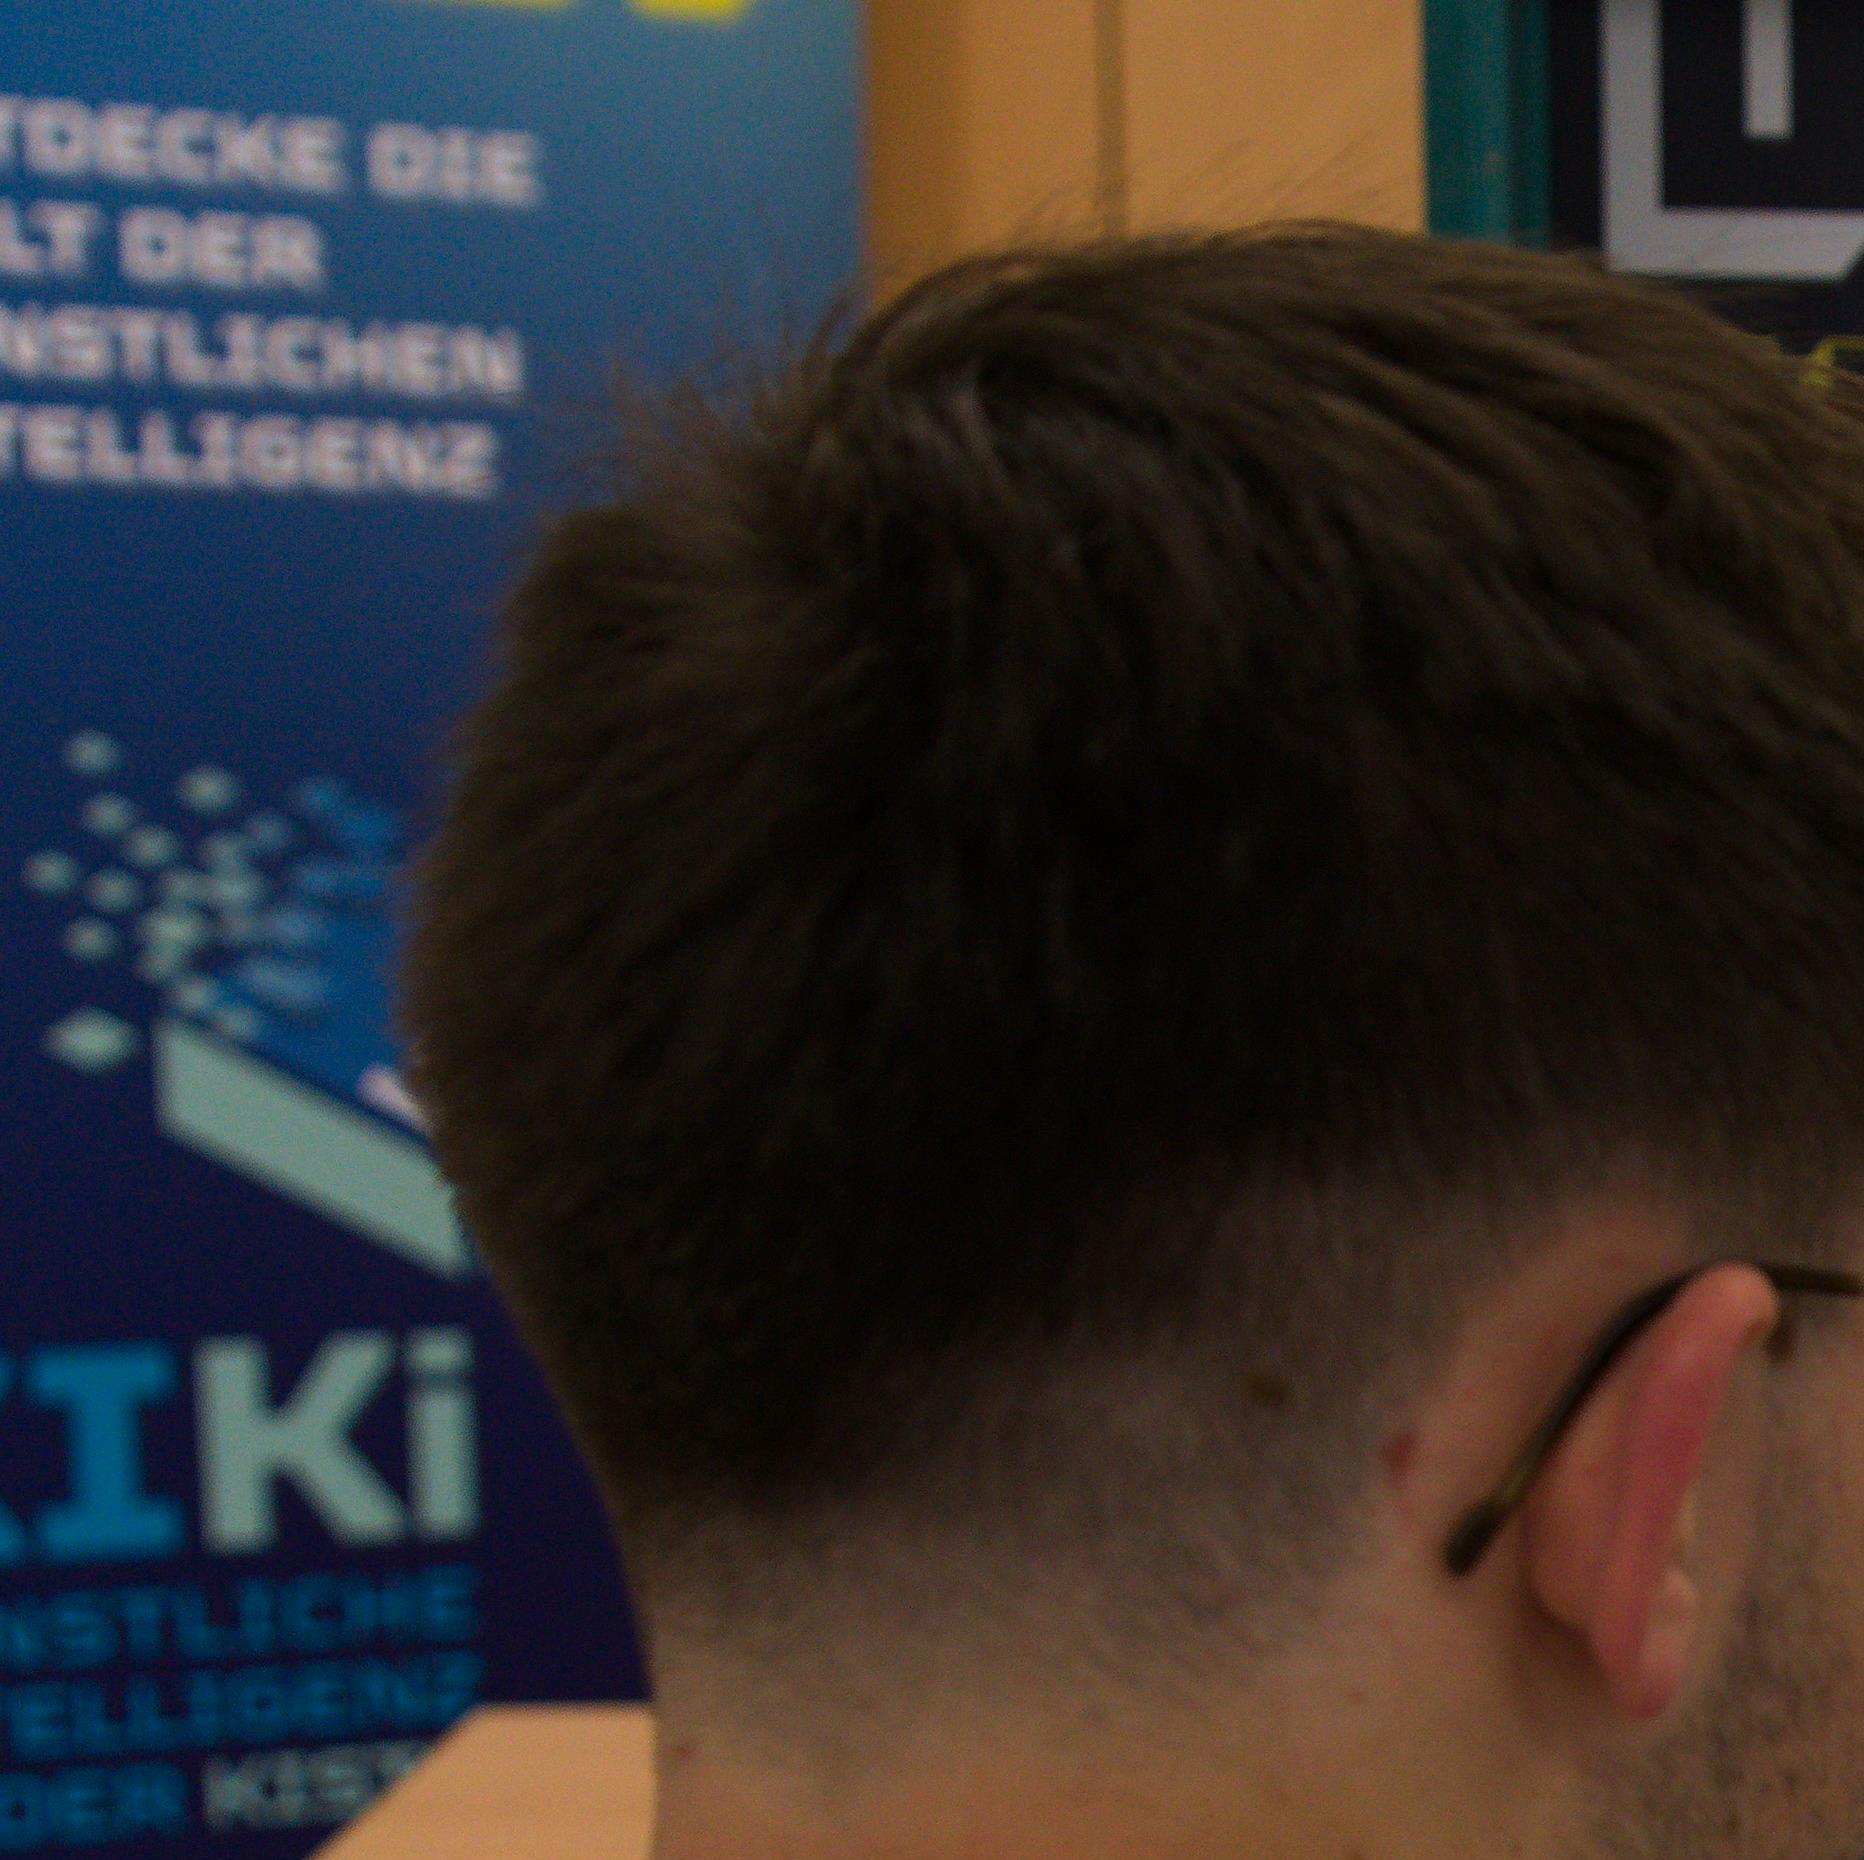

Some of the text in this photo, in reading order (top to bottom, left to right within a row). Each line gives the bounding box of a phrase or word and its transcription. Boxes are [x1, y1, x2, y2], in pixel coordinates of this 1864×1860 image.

[366, 122, 536, 203] DIE
[117, 206, 323, 288] DER
[0, 1330, 477, 1556] IKi
[0, 1652, 485, 1758] ELLIGENZ
